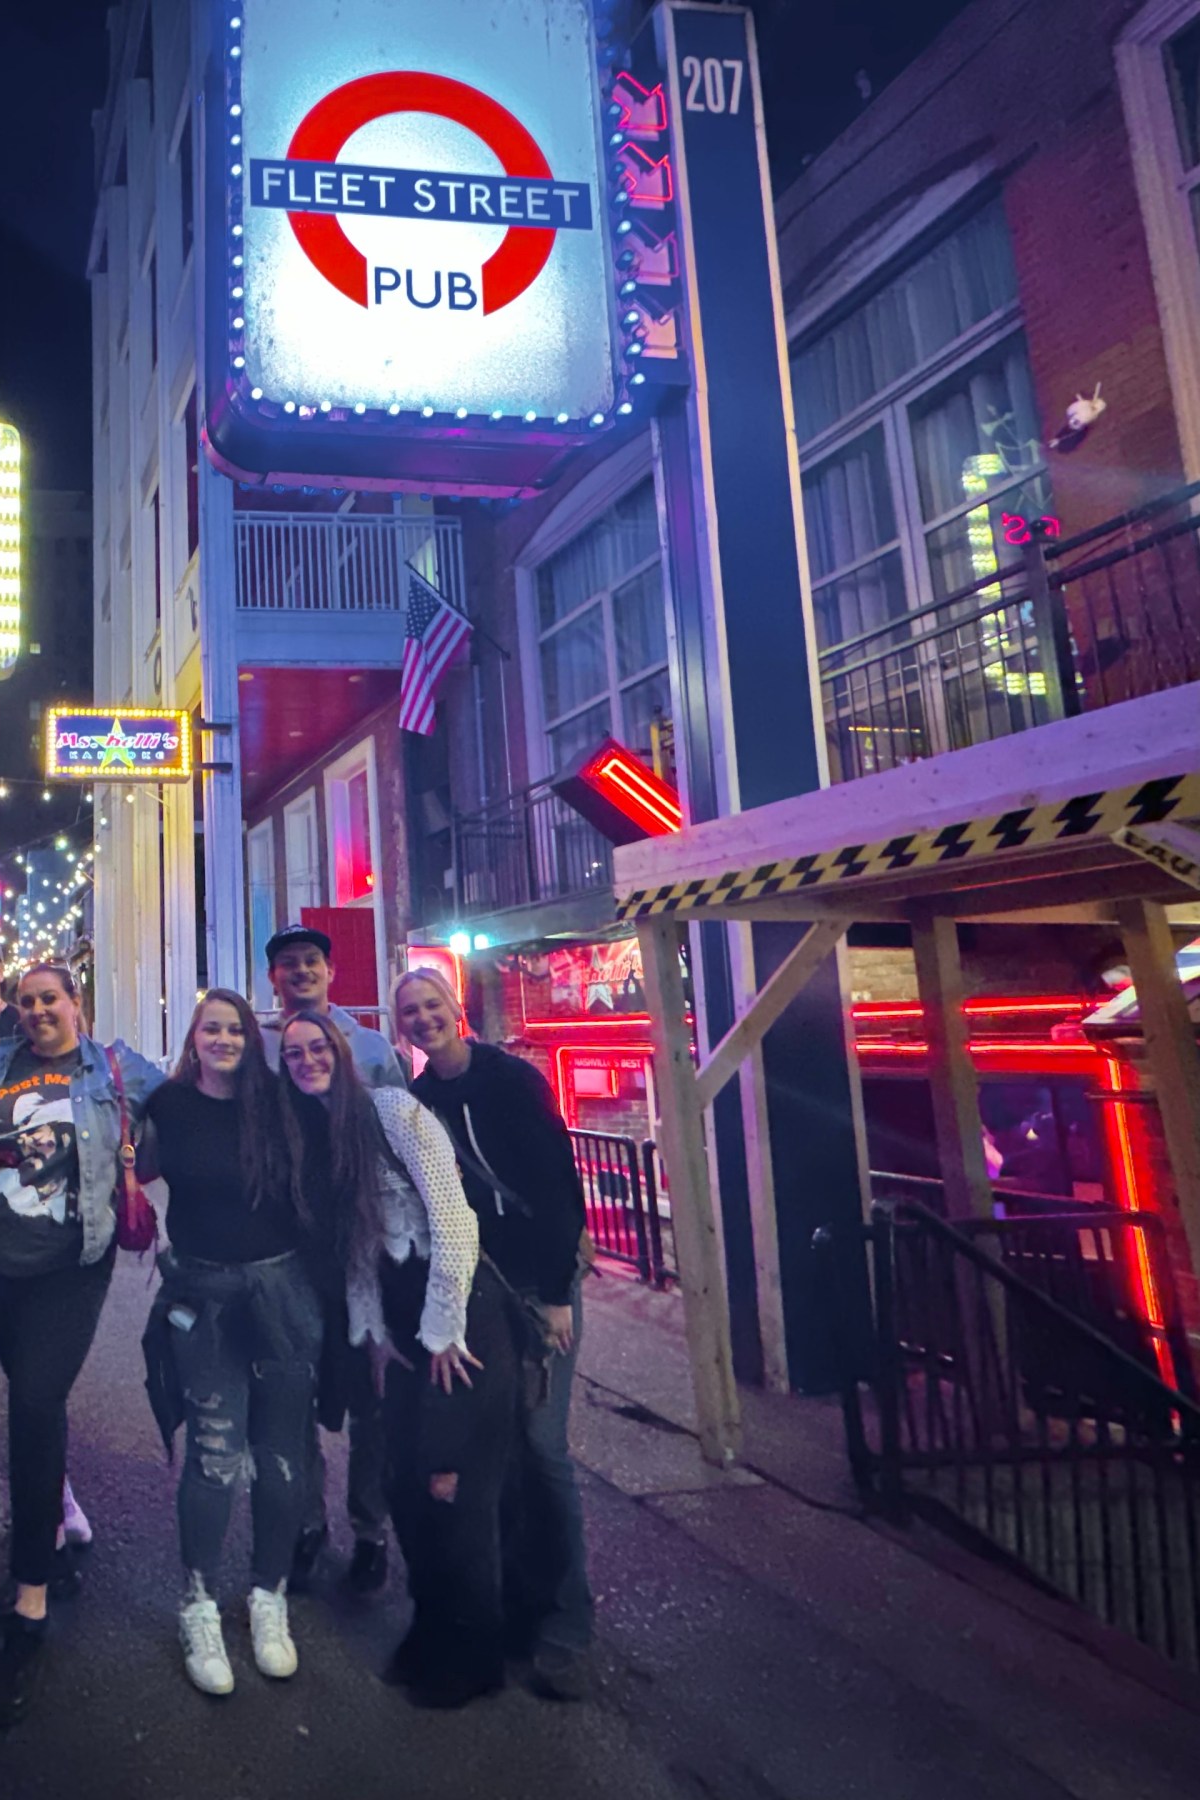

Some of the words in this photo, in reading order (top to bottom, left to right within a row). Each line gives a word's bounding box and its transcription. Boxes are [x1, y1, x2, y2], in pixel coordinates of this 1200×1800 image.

[683, 56, 742, 114] 207
[262, 167, 395, 209] FLEET
[414, 178, 580, 222] STREET
[374, 266, 478, 311] PUB
[621, 1058, 641, 1069] BEST
